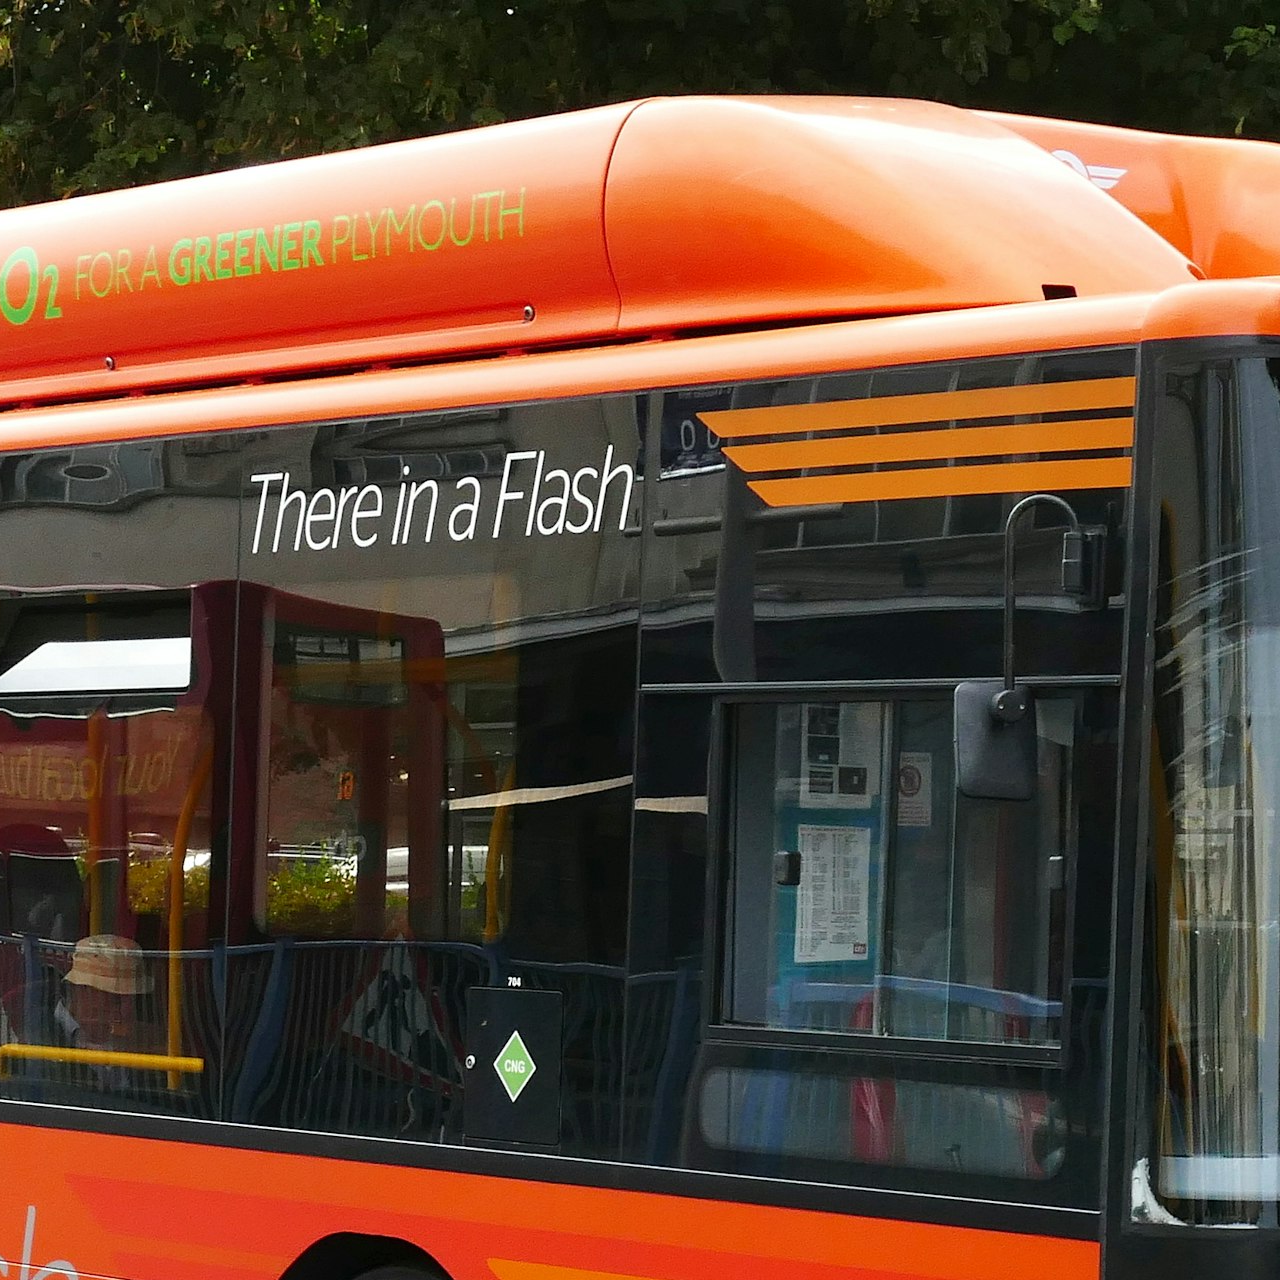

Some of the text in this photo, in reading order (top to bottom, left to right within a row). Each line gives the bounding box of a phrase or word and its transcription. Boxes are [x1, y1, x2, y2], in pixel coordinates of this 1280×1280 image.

[76, 249, 133, 300] FOR
[140, 245, 162, 290] A
[168, 220, 324, 286] GREENER
[331, 187, 526, 263] PLYMOUTH
[251, 444, 634, 554] There in a Flash
[504, 1059, 525, 1073] CNG
